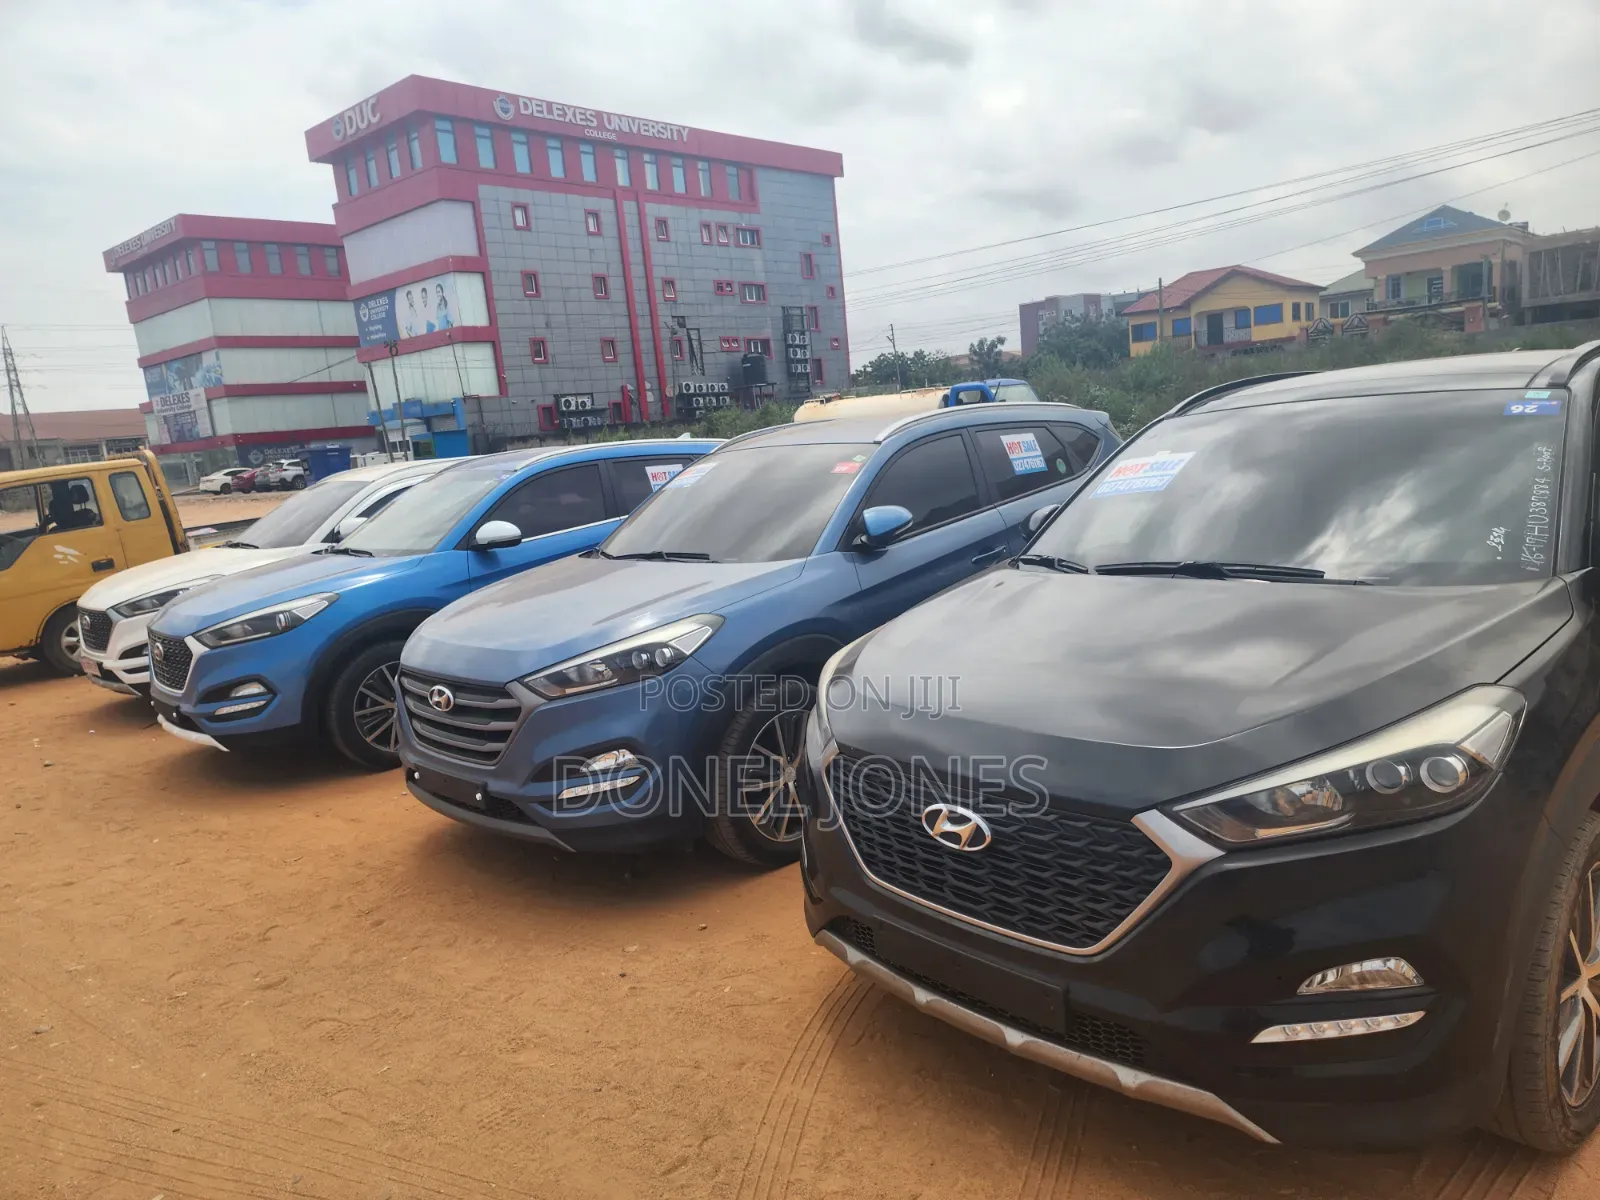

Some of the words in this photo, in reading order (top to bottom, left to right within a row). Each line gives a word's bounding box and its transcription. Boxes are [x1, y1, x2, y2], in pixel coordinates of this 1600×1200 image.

[344, 97, 382, 136] DUC
[518, 98, 598, 127] DELEXES
[602, 113, 690, 142] UNIVERSITY
[584, 129, 617, 141] COLLEGE
[151, 217, 176, 246] UVERSITY
[160, 392, 190, 407] DELEXES
[1006, 441, 1023, 454] HOT
[1022, 439, 1039, 453] SALE
[651, 471, 667, 482] HOT
